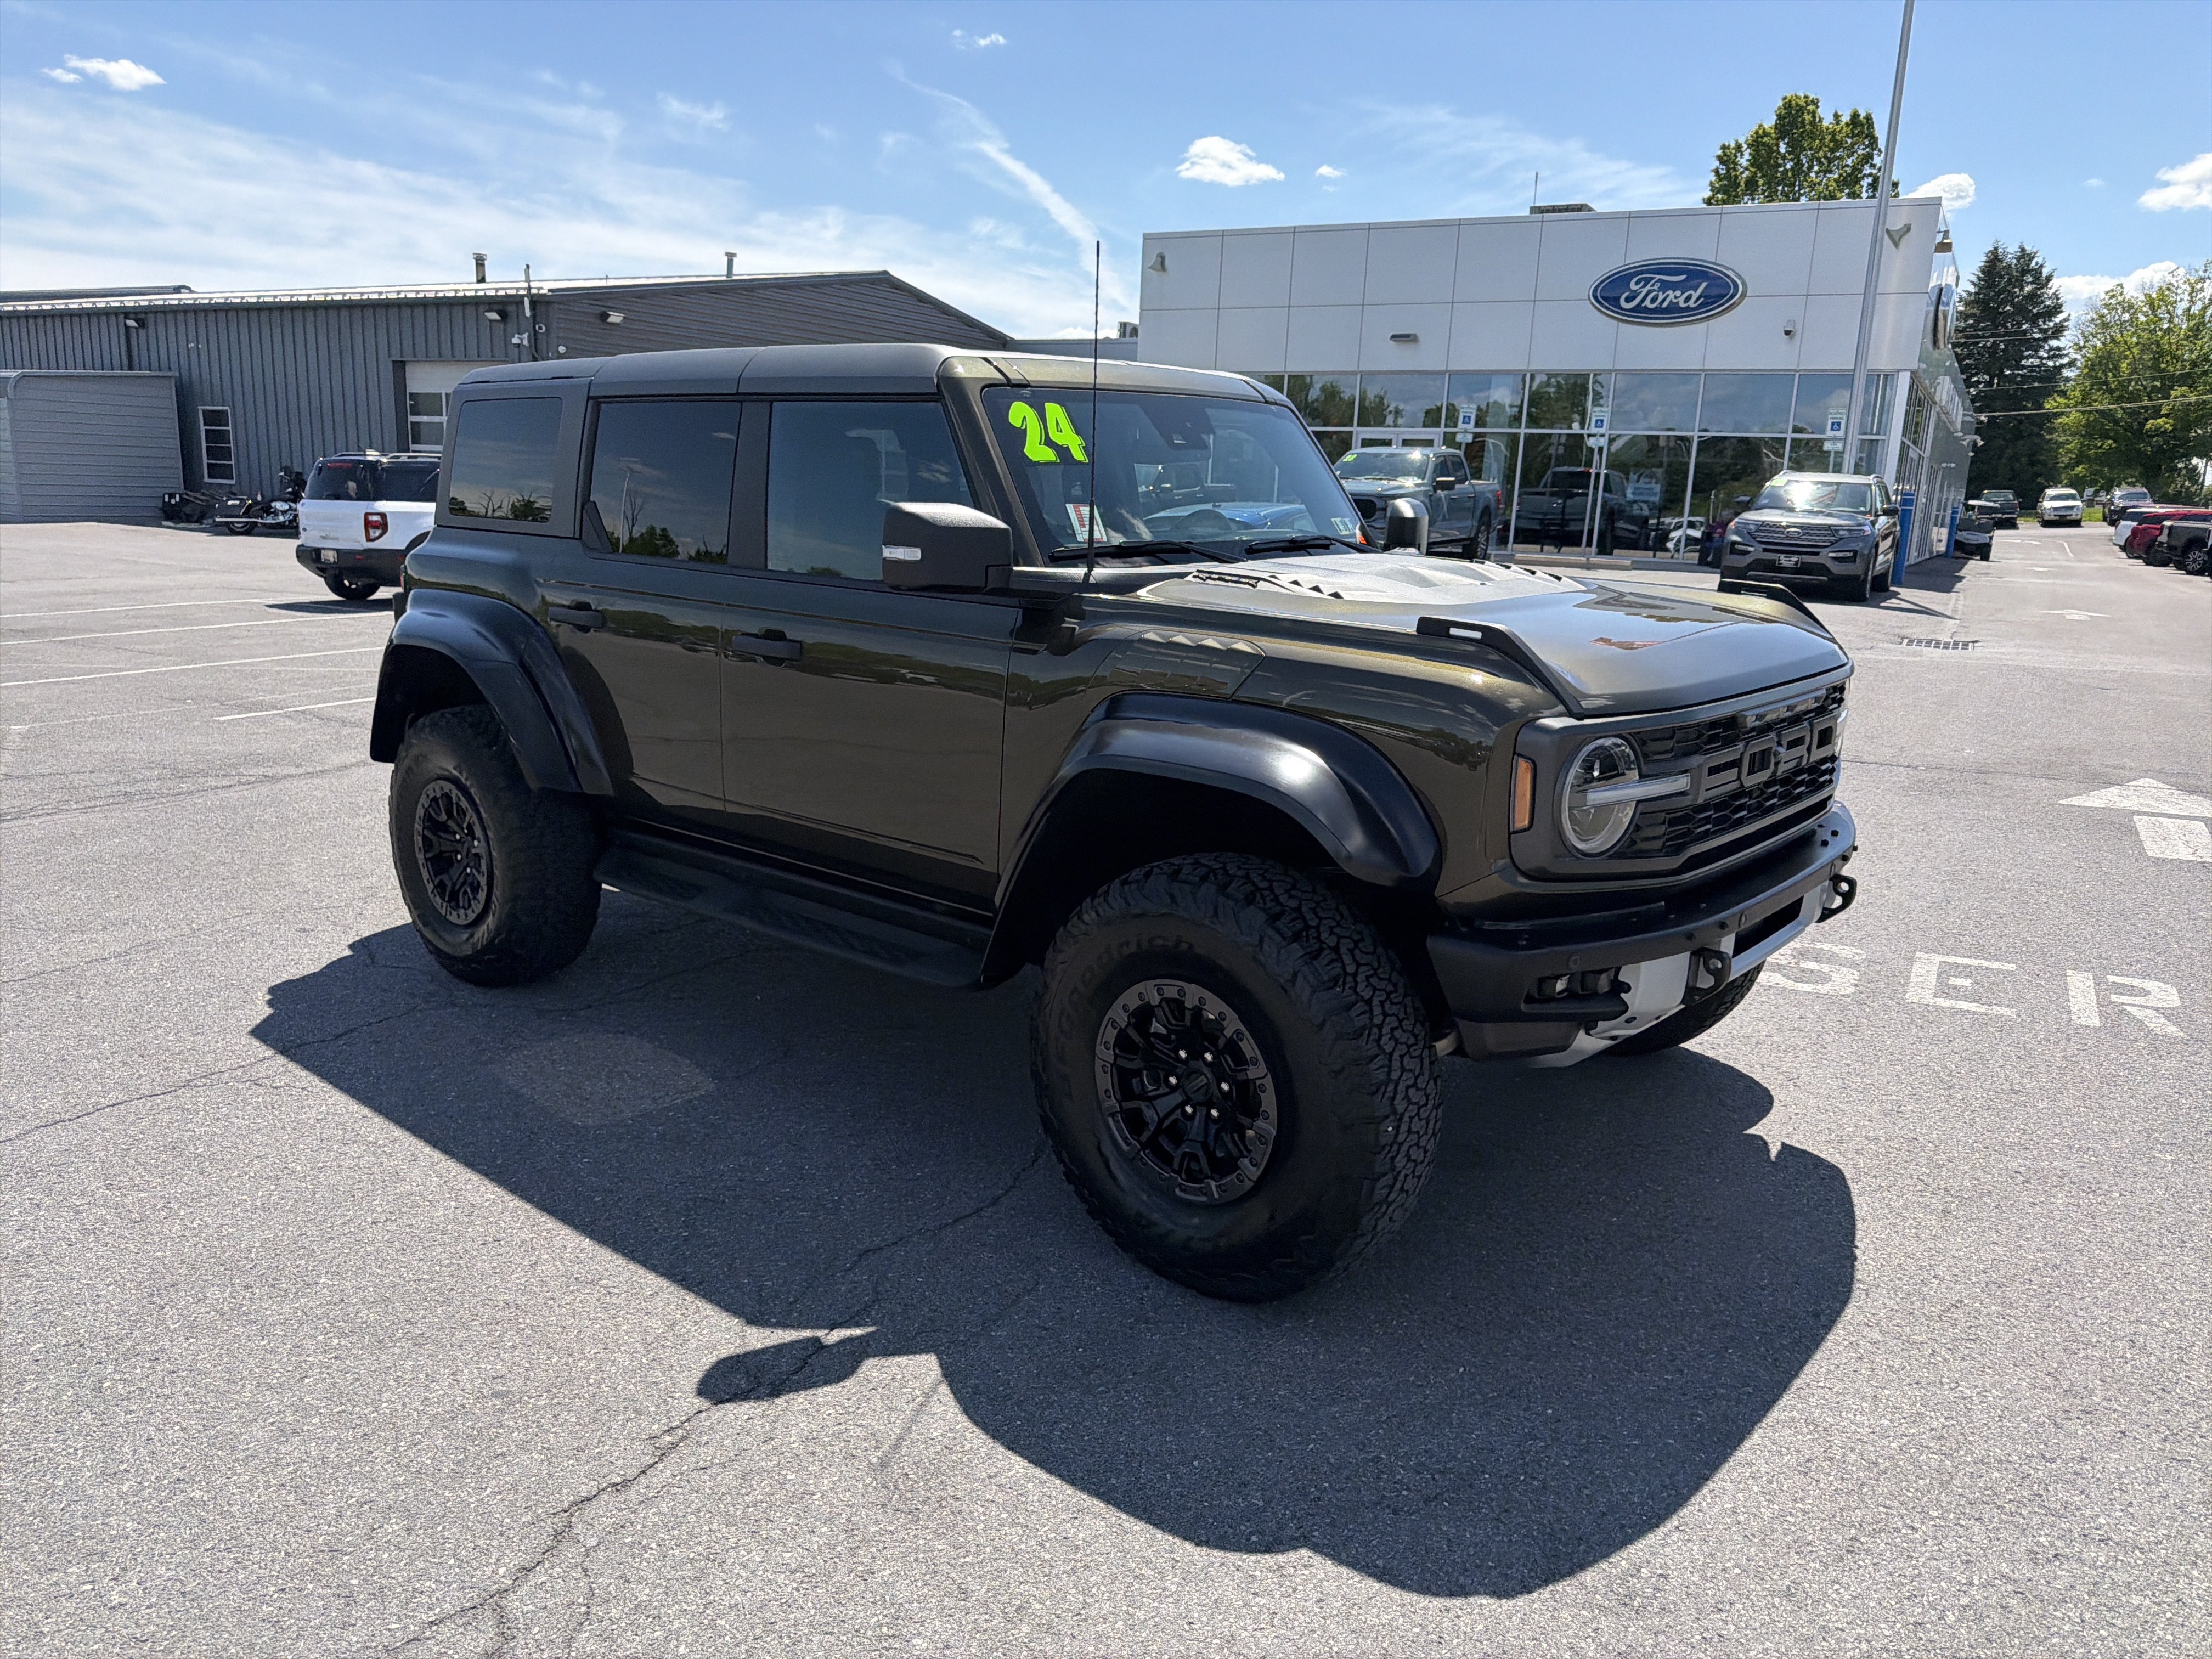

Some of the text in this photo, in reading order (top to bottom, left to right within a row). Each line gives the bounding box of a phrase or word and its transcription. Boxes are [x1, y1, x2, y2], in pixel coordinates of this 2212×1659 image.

[1620, 274, 1708, 309] Ford
[1008, 401, 1089, 462] 24
[1697, 712, 1838, 804] FORD
[1756, 941, 2189, 1037] SER
